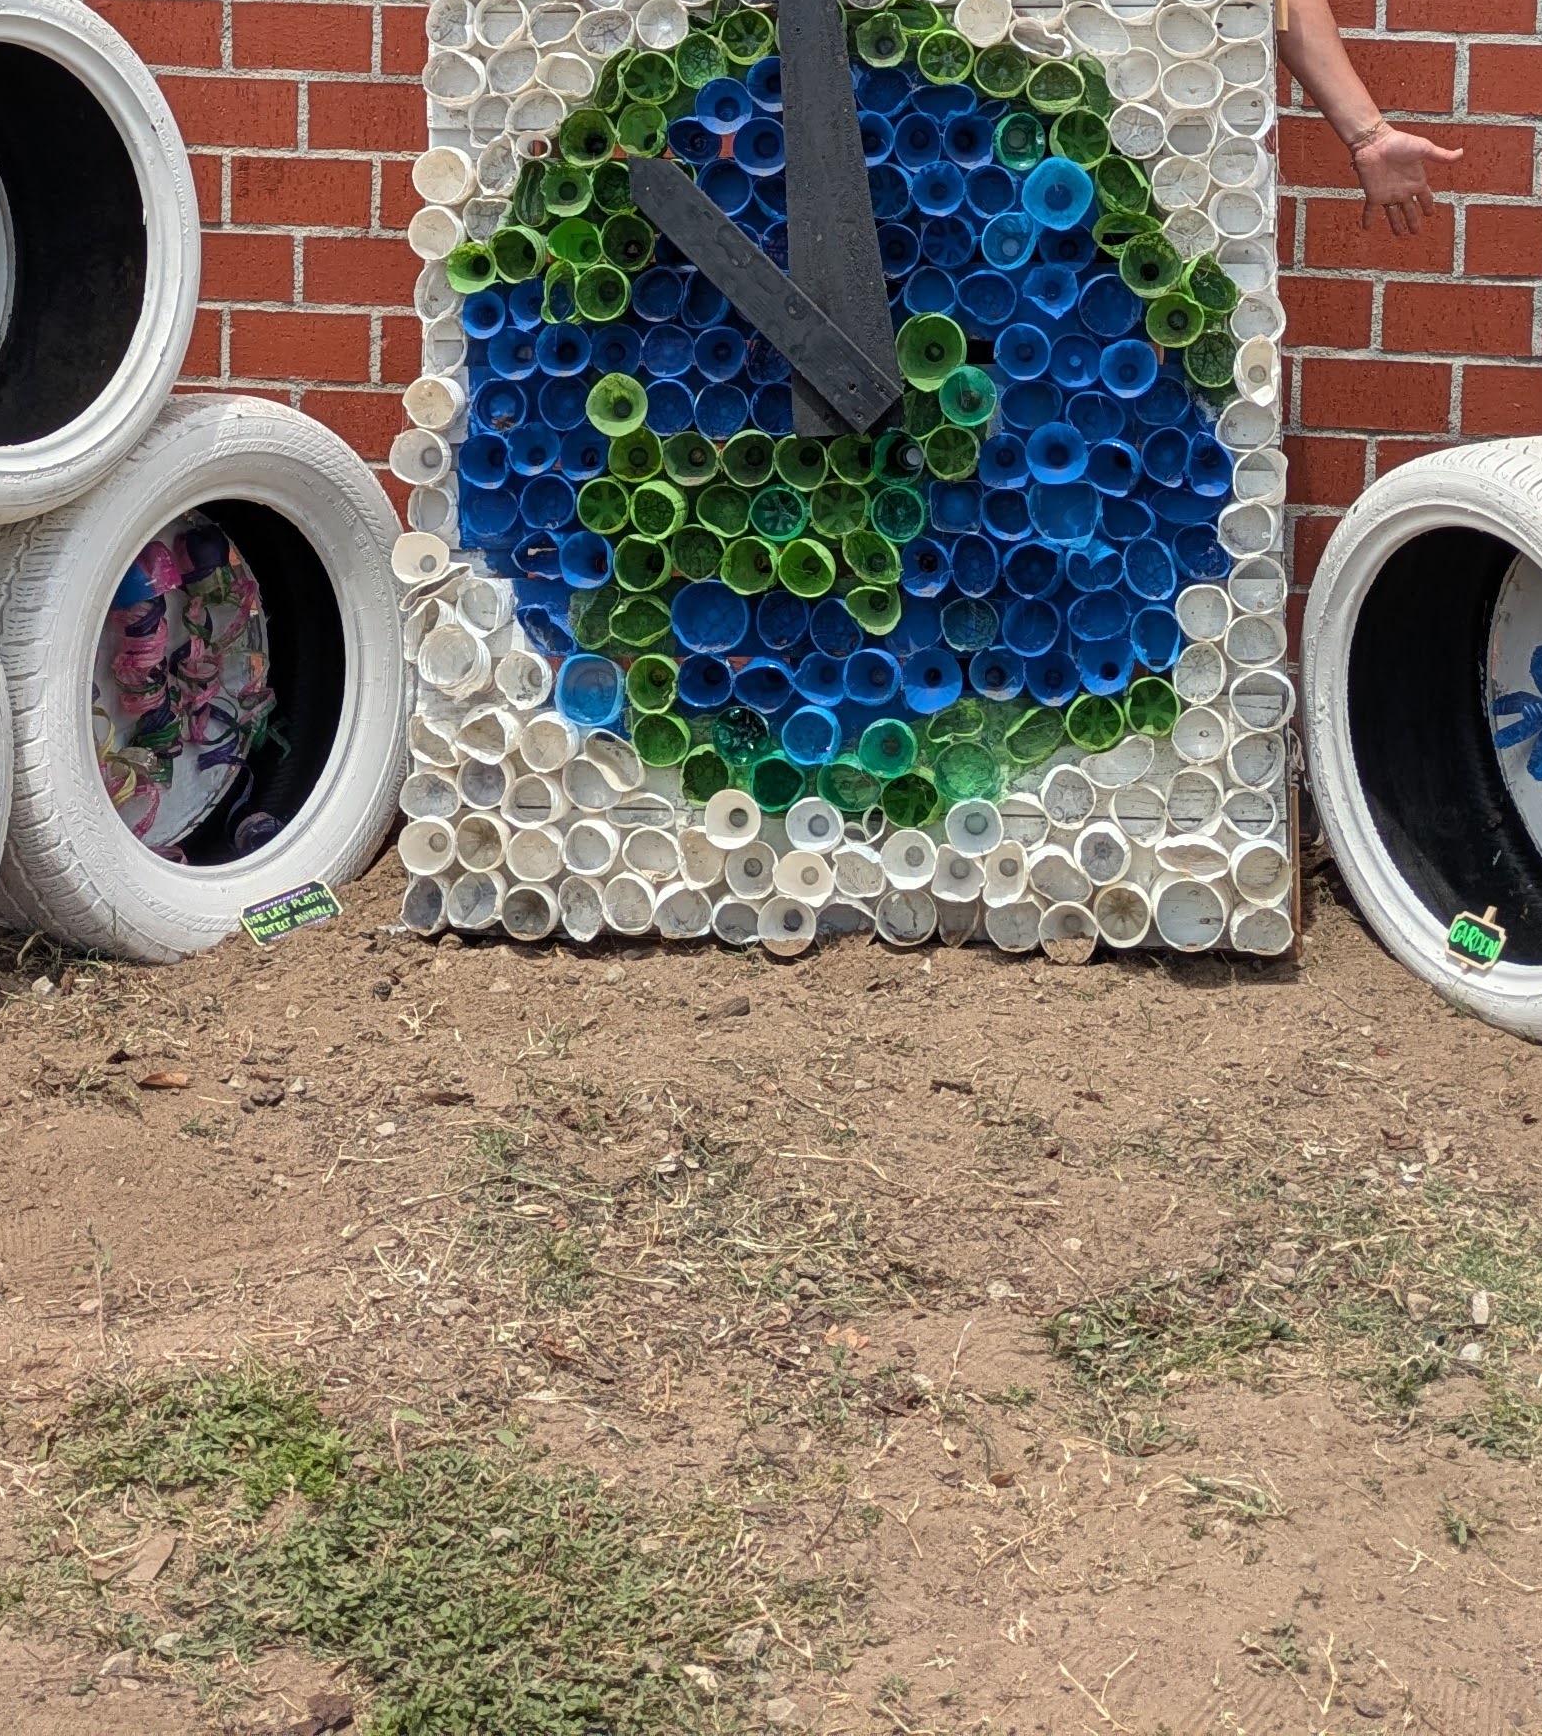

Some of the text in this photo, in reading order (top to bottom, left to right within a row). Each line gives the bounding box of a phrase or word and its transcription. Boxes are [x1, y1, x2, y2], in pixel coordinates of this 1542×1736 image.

[244, 889, 330, 926] USE LESS PLASTIC
[253, 903, 334, 937] PROTECT ANIMALS
[1450, 920, 1500, 959] GARDEN
